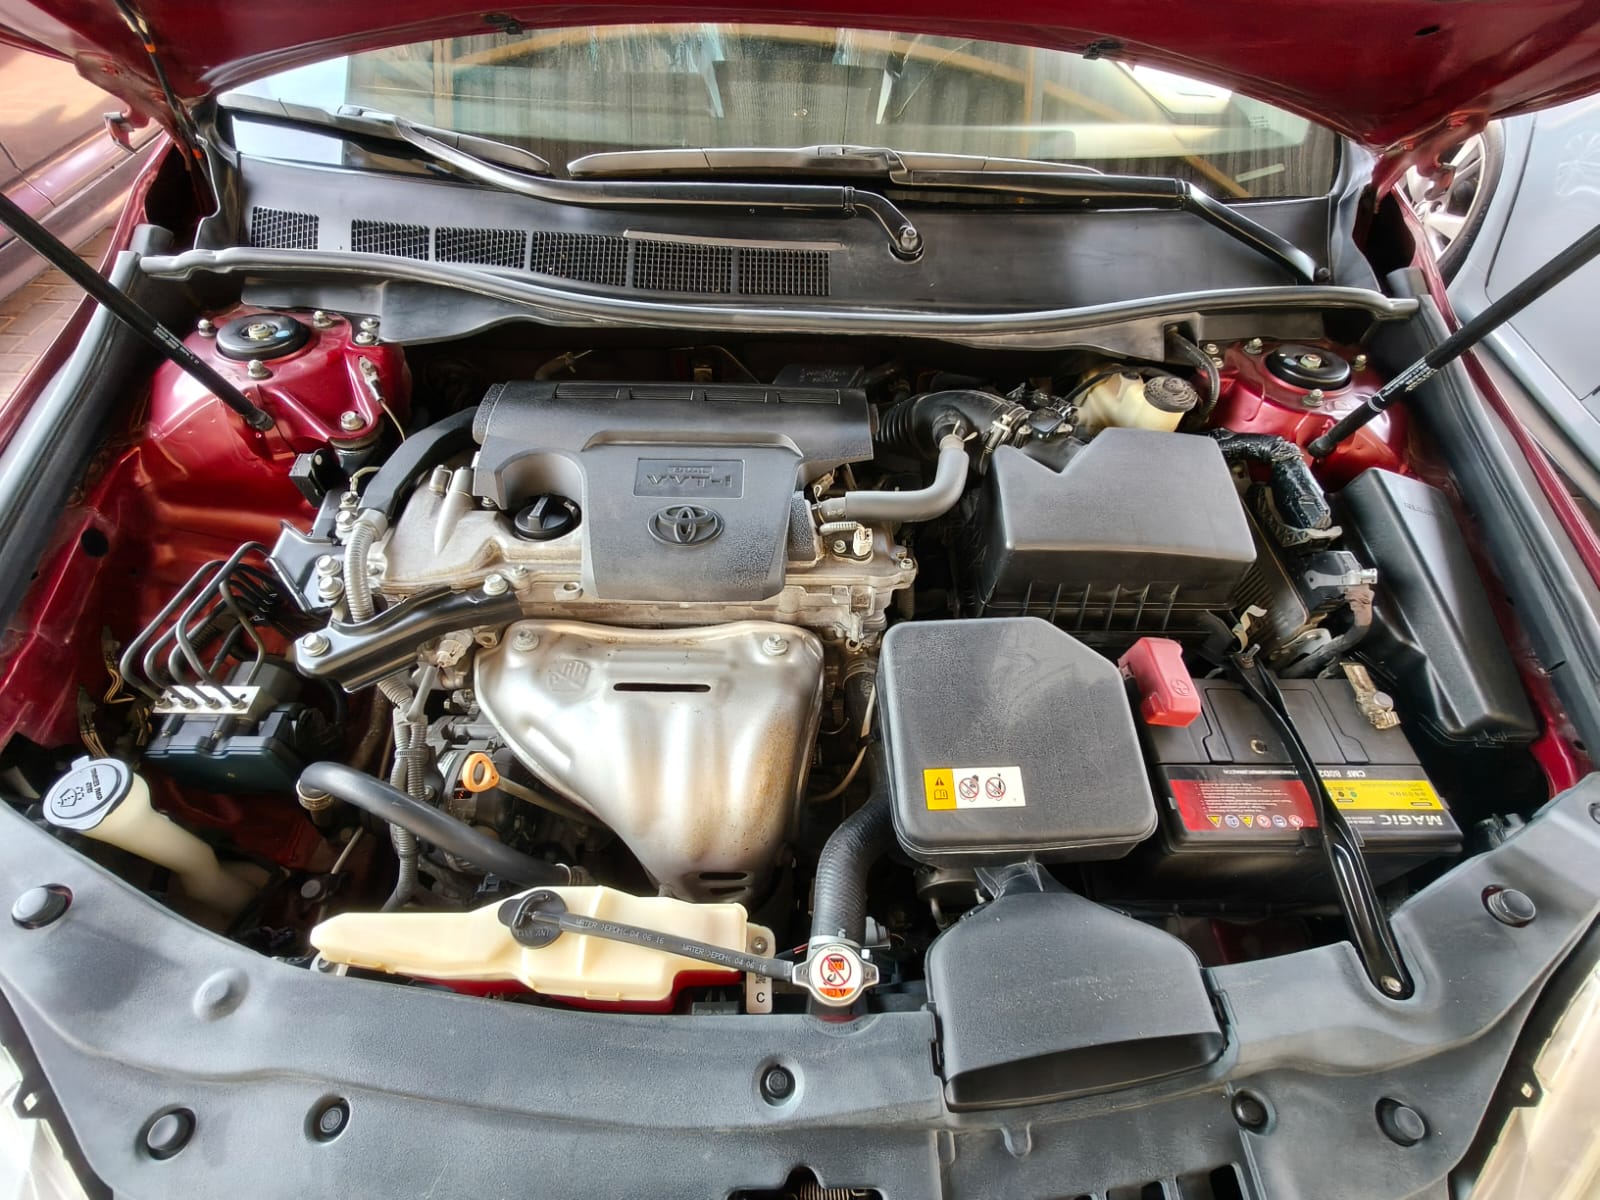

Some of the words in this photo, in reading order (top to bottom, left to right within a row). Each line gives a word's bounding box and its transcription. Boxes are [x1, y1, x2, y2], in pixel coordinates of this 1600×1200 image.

[1346, 768, 1366, 778] CMF
[1378, 814, 1443, 826] MAGIC
[576, 918, 598, 928] WATER
[655, 936, 665, 945] 16
[682, 943, 705, 955] WATER
[755, 991, 765, 1003] C
